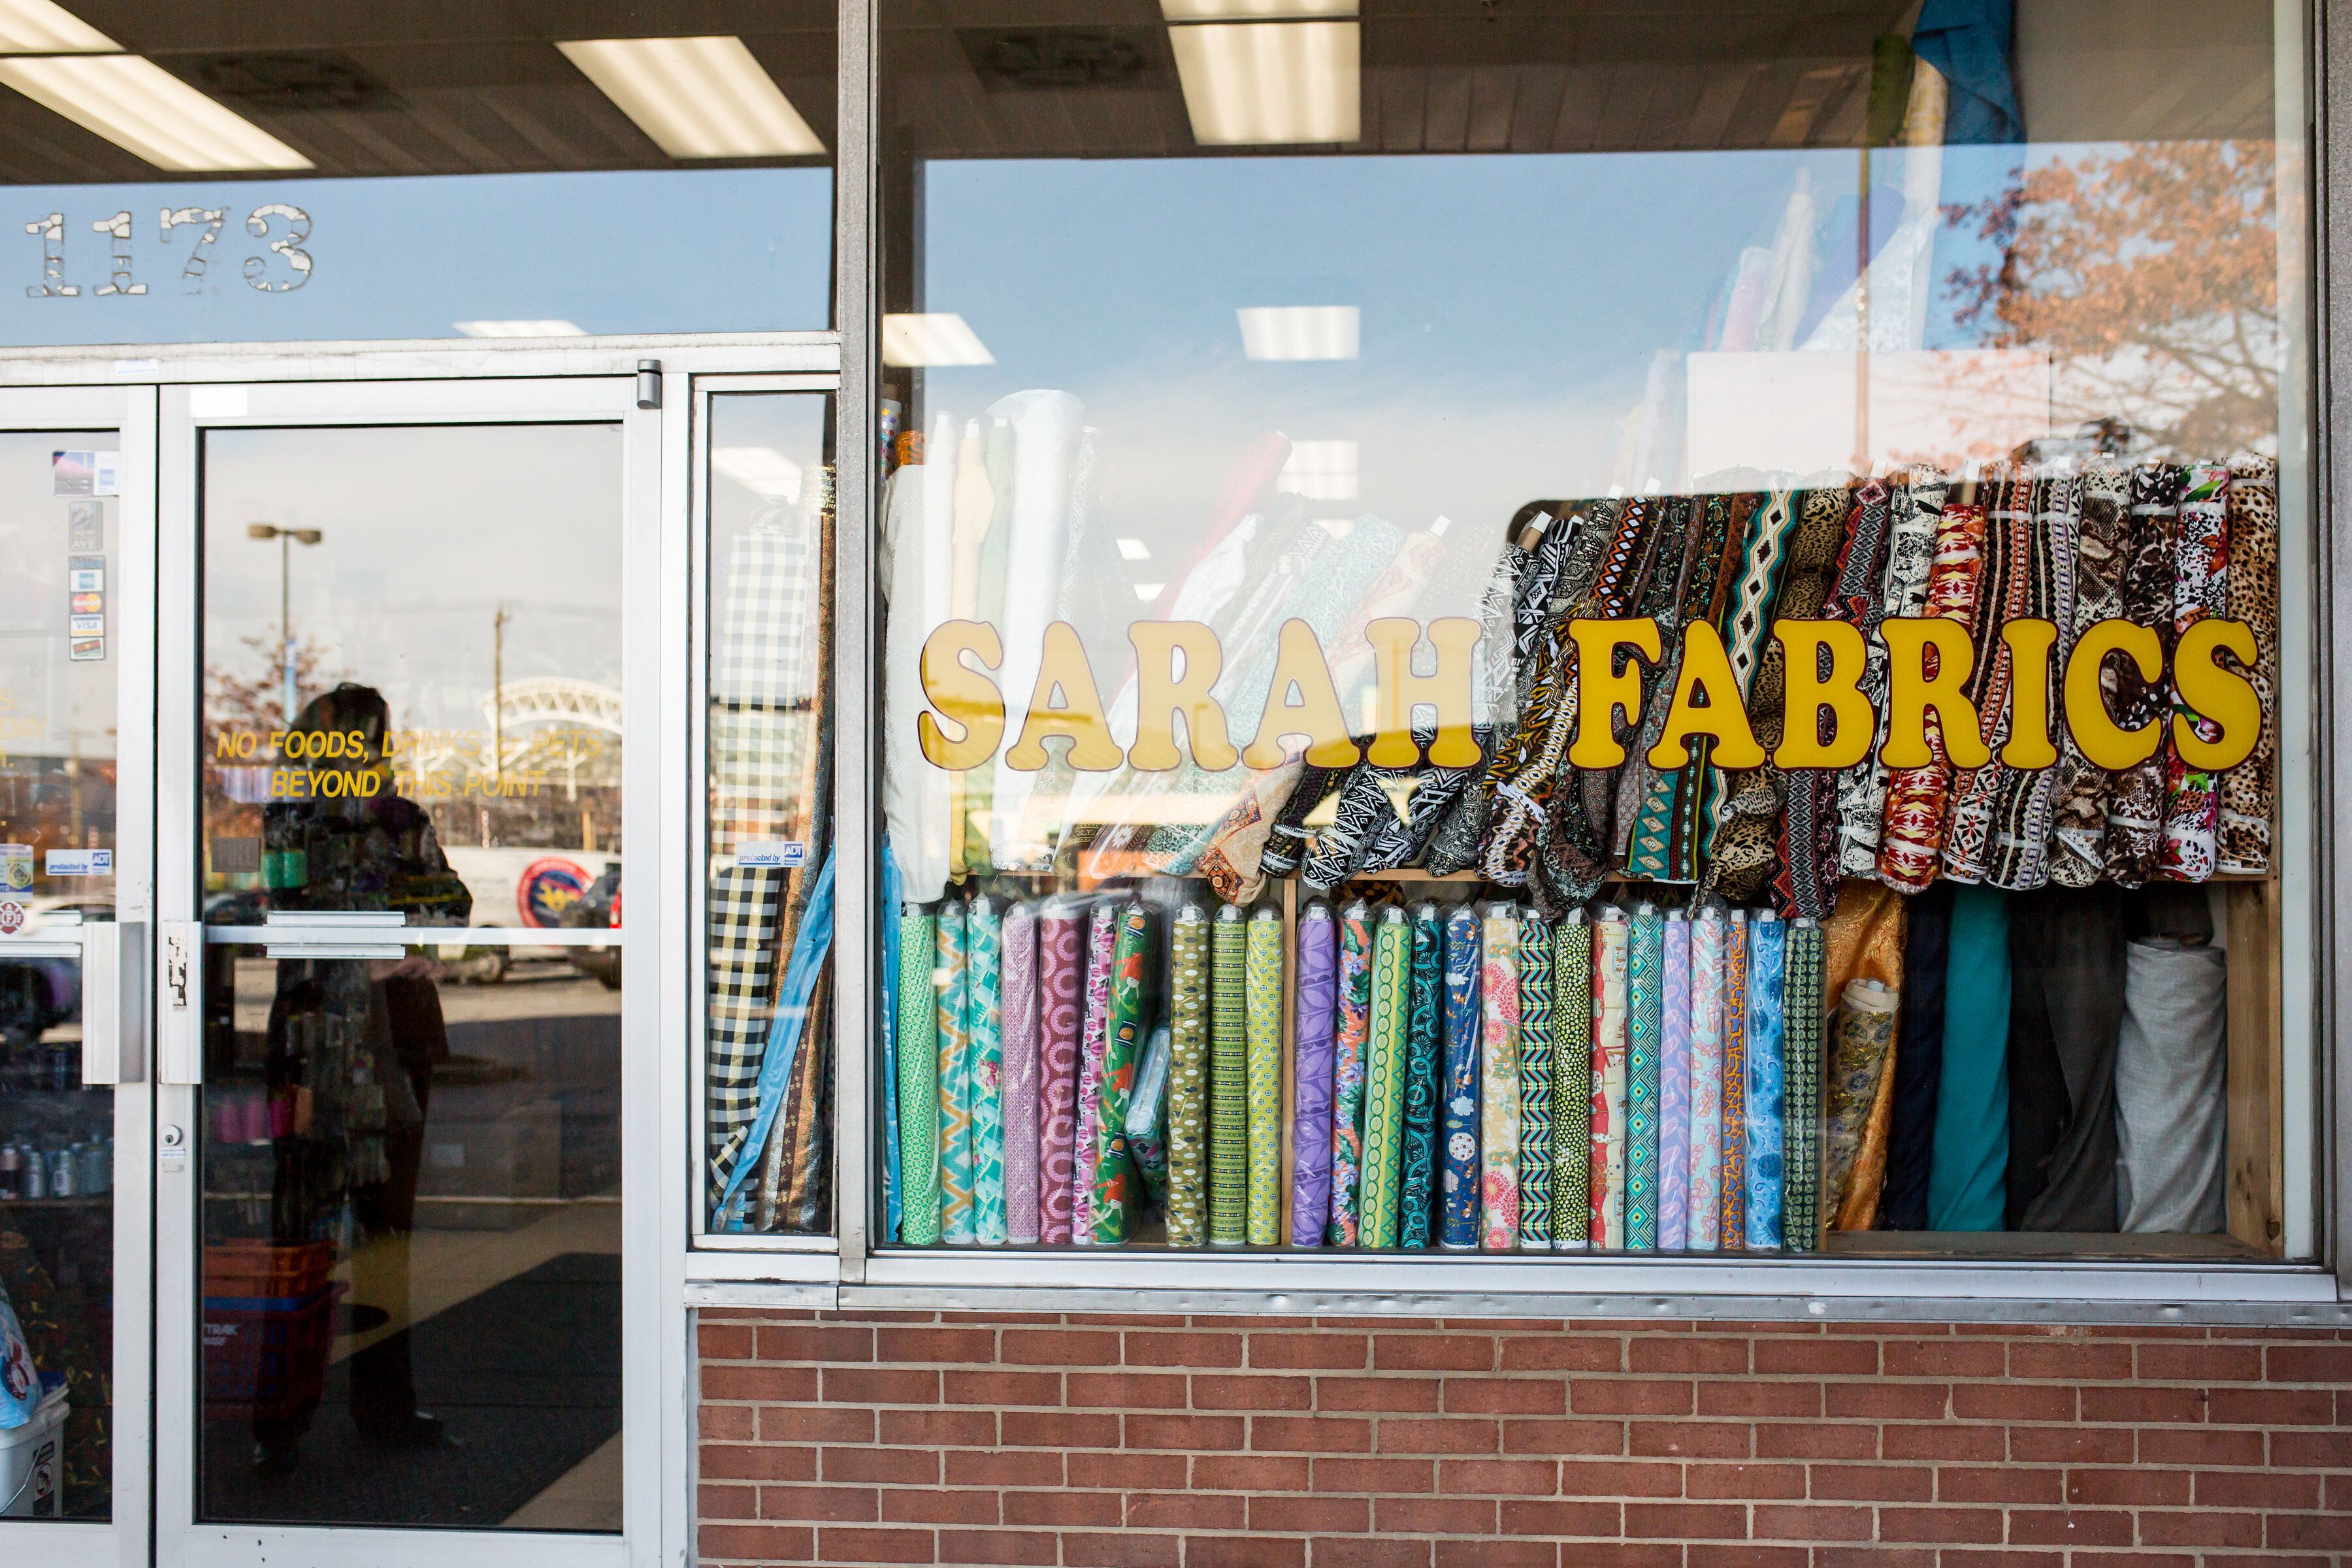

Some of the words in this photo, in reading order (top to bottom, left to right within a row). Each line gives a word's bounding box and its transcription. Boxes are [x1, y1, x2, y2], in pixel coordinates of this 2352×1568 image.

[25, 203, 314, 297] 1173
[918, 617, 1483, 772] SARAH
[1565, 615, 2264, 772] FABRICS
[217, 731, 257, 759] NO
[269, 730, 368, 763] FOODS,
[382, 730, 482, 758] DRINKS
[497, 737, 521, 757] or
[532, 729, 603, 758] PETS
[270, 770, 380, 798] BEYOND
[393, 770, 453, 798] THIS
[464, 770, 546, 798] POINT
[93, 854, 108, 864] ADT
[739, 854, 772, 862] protected
[772, 854, 781, 862] by
[785, 845, 802, 856] ADT
